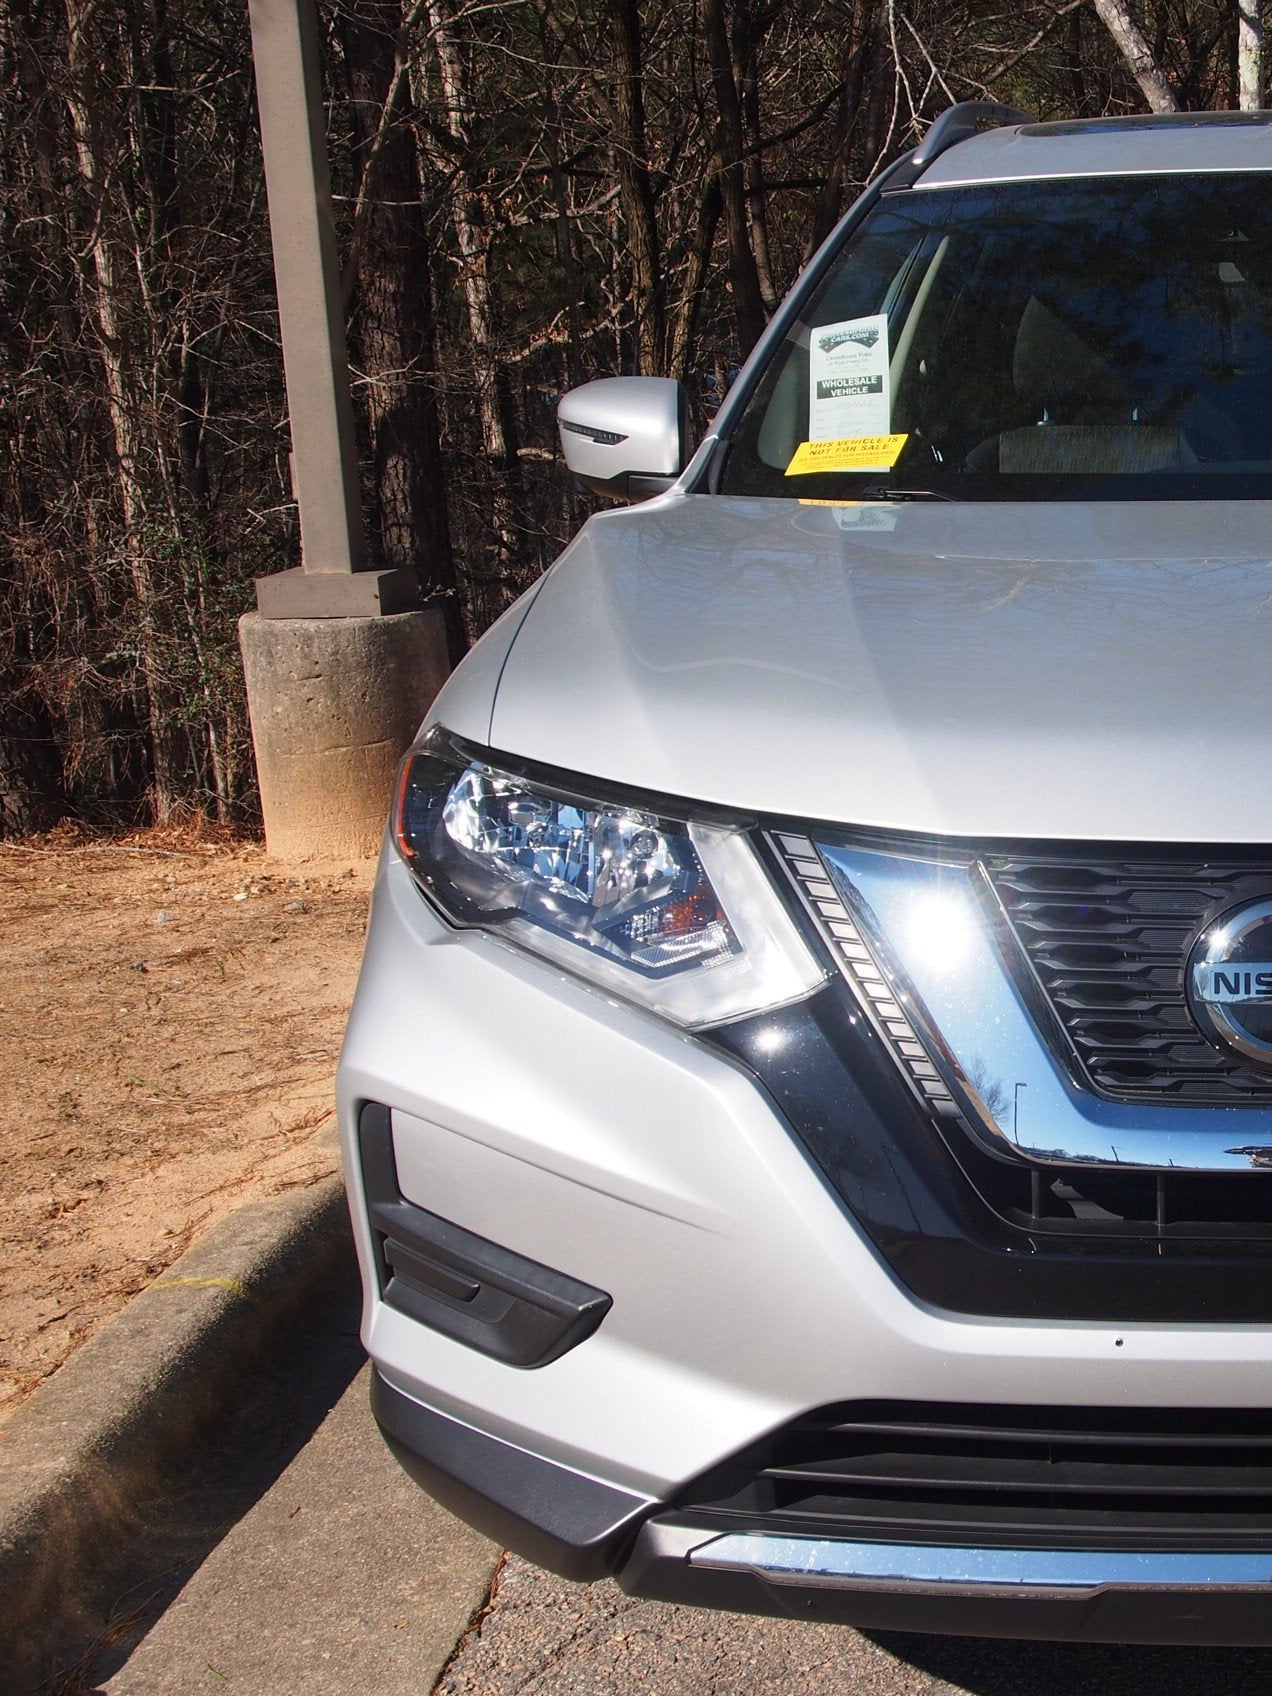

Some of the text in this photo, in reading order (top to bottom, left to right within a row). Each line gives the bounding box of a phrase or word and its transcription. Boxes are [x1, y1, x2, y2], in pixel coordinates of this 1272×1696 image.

[821, 375, 878, 388] WHOLESALE
[831, 386, 869, 397] VEHICLE
[808, 441, 834, 450] THIS
[837, 437, 884, 447] VEHICLE
[860, 443, 890, 451] SALE
